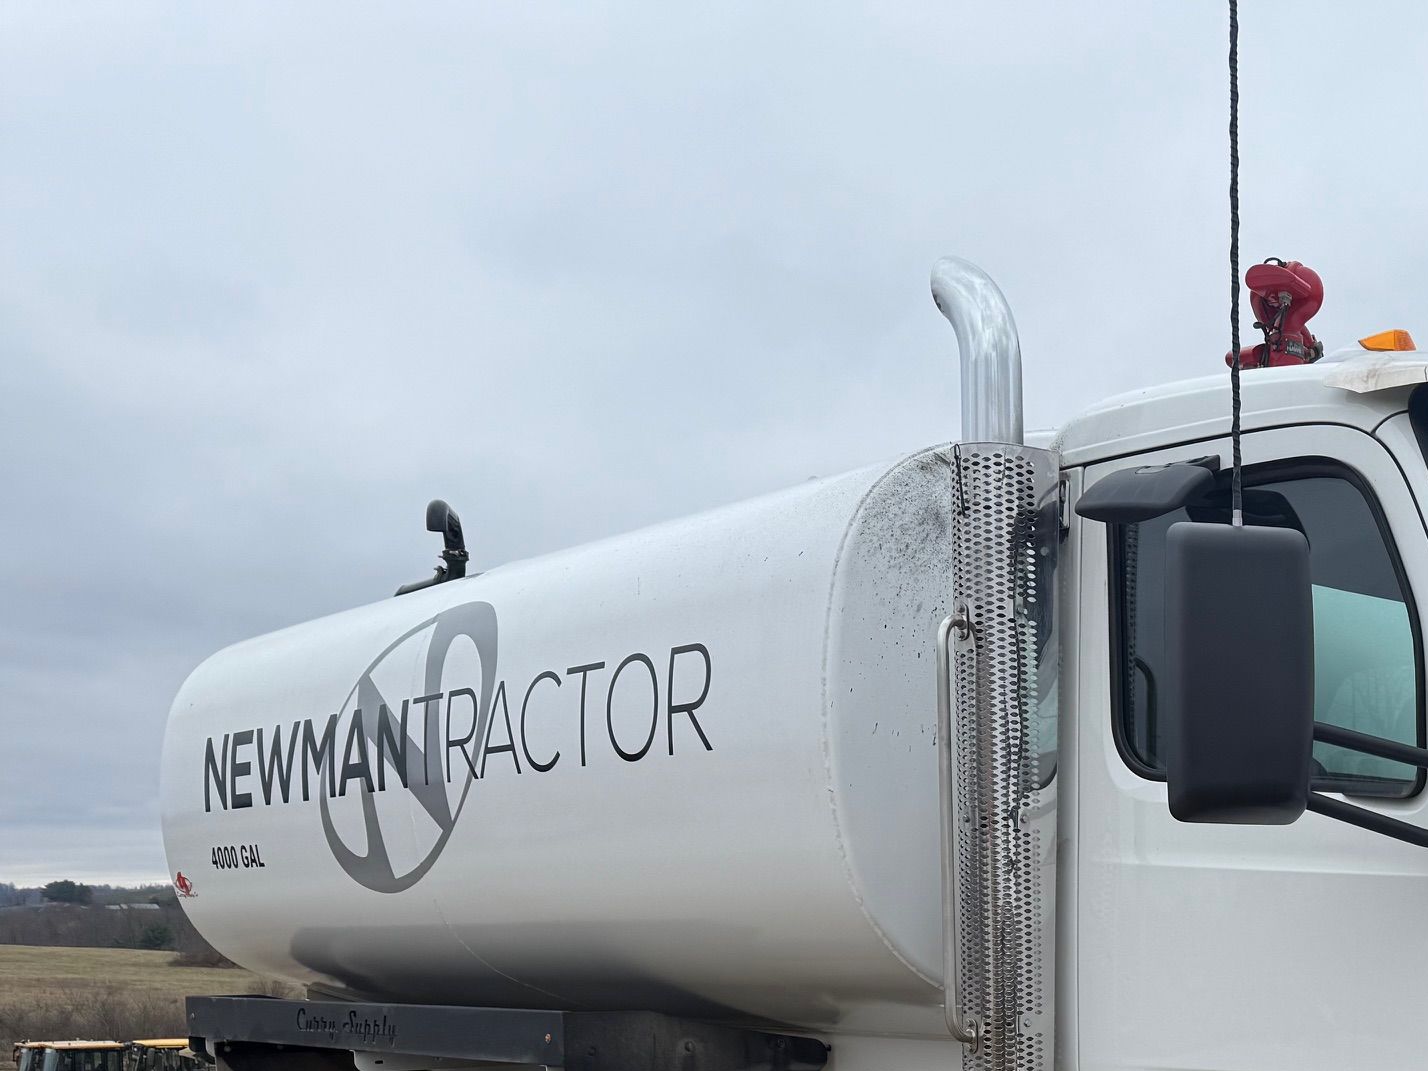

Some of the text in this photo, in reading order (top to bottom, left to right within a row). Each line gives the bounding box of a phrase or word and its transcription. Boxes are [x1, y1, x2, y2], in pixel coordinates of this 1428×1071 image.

[211, 844, 265, 869] 4000 GAL
[297, 1008, 398, 1047] Curry Supply
